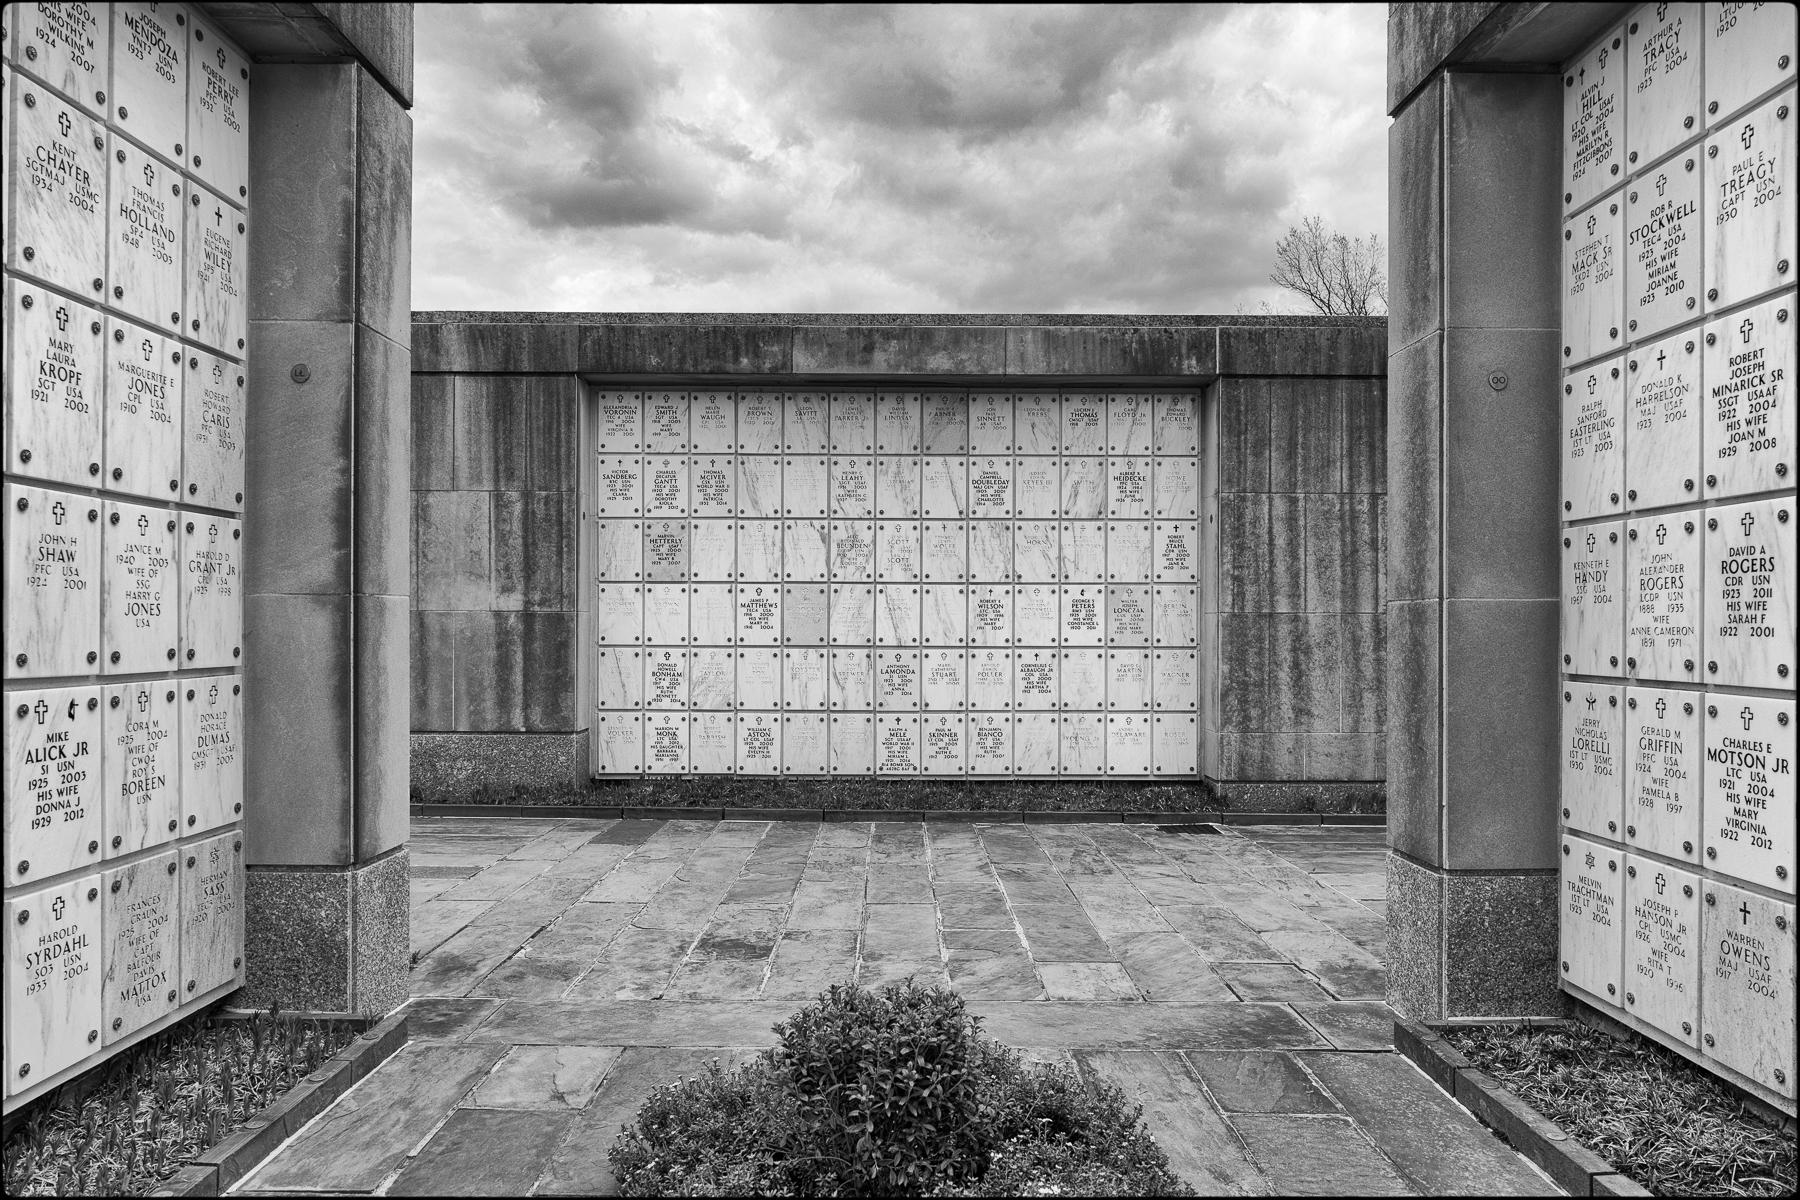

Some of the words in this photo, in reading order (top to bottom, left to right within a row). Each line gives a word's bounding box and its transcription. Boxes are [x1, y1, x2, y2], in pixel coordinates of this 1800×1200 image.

[140, 12, 166, 39] JOSEPH
[1643, 23, 1674, 52] ARTHUR
[1677, 17, 1682, 26] A
[48, 22, 85, 56] WILKINS
[124, 13, 179, 64] MENDOZA
[1643, 29, 1681, 65] TRACY
[36, 27, 56, 48] 1924
[71, 52, 94, 74] 2007
[158, 54, 173, 71] USN
[207, 77, 234, 107] PERRY
[1582, 91, 1603, 113] HILL
[52, 140, 76, 162] KENT
[36, 145, 90, 187] CHAYER
[1732, 157, 1755, 176] PAUL
[26, 157, 65, 186] SGTMAJ
[75, 182, 100, 204] USMC
[69, 193, 94, 214] 2004
[1721, 191, 1745, 210] CAPT
[120, 203, 175, 243] HOLLAND
[1630, 200, 1696, 245] STOCKWELL
[1716, 208, 1738, 226] 1930
[204, 248, 232, 273] WILEY
[1646, 271, 1678, 292] JOANNE
[1665, 280, 1684, 295] 2010
[48, 337, 74, 353] MARY
[46, 350, 76, 367] LAURA
[1729, 348, 1764, 367] ROBERT
[39, 360, 82, 386] KROPF
[1729, 361, 1765, 380] JOSEPH
[66, 386, 83, 399] USA
[128, 377, 166, 399] JONES
[1712, 376, 1765, 398] MINARICK
[1771, 369, 1784, 382] SR
[1636, 384, 1689, 408] HARRELSON
[1718, 395, 1739, 409] SSGT
[1747, 385, 1778, 402] USAAF
[64, 398, 89, 414] 2002
[1718, 409, 1736, 422] 1922
[1748, 399, 1777, 415] 2004
[202, 411, 230, 429] CARIS
[1570, 418, 1615, 438] EASTERLING
[1726, 419, 1741, 432] HIS
[1745, 414, 1768, 427] WIFE
[1728, 431, 1755, 444] JOAN
[1758, 428, 1766, 437] M
[1718, 446, 1737, 458] 1929
[1749, 438, 1776, 453] 2008
[38, 533, 66, 545] JOHN
[38, 546, 77, 562] SHAW
[1729, 546, 1755, 557] DAVID
[1760, 545, 1766, 554] A
[35, 564, 51, 575] PFC
[62, 566, 79, 577] USA
[188, 560, 222, 575] GRANT
[1640, 564, 1684, 576] ALEXANDER
[1721, 557, 1775, 574] ROGERS
[1574, 570, 1608, 584] HANDY
[1640, 576, 1684, 590] ROGERS
[1725, 576, 1744, 586] CDR
[1752, 575, 1771, 585] USN
[125, 591, 152, 600] HARRY
[1722, 589, 1741, 599] 1923
[1753, 588, 1772, 598] 2011
[124, 603, 161, 616] JONES
[1667, 604, 1684, 613] 1935
[1726, 601, 1741, 611] HIS
[1745, 601, 1767, 611] WIFE
[1728, 614, 1758, 624] SARAH
[1761, 614, 1766, 623] F
[1631, 627, 1651, 635] ANNE
[1654, 626, 1694, 635] CAMERON
[1720, 627, 1738, 636] 1922
[1750, 626, 1775, 637] 2001
[46, 732, 69, 743] MIKE
[198, 733, 231, 748] DUMAS
[1572, 737, 1610, 754] LORELLI
[1639, 737, 1683, 754] GRIFFIN
[1723, 737, 1763, 752] CHARLES
[1766, 744, 1772, 754] E
[25, 745, 67, 764] ALICK
[73, 742, 89, 756] JR
[1707, 748, 1765, 770] MOTSON
[1772, 758, 1789, 774] JR
[56, 760, 75, 772] USN
[1726, 767, 1742, 779] LTC
[1750, 772, 1767, 783] USA
[61, 771, 87, 784] 2003
[121, 776, 166, 797] BOREEN
[1652, 777, 1669, 788] WIFE
[37, 788, 55, 801] HIS
[56, 784, 79, 799] WIFE
[1642, 787, 1672, 800] PAMELA
[1719, 779, 1735, 790] 1921
[1747, 784, 1775, 798] 2004
[35, 800, 73, 815] DONNA
[136, 793, 152, 804] USN
[1726, 792, 1741, 804] HIS
[1744, 796, 1767, 810] WIFE
[31, 815, 51, 830] 1929
[64, 808, 85, 822] 2012
[1734, 806, 1759, 821] MARY
[1726, 817, 1767, 836] VIRGINIA
[1720, 828, 1739, 841] 1922
[1751, 836, 1772, 850] 2012
[1567, 880, 1614, 906] TRACHTMAN
[1642, 898, 1671, 915] JOSEPH
[1635, 906, 1672, 929] HANSON
[1678, 923, 1687, 935] JR
[39, 924, 78, 946] HAROLD
[1726, 929, 1765, 951] WARREN
[26, 934, 89, 970] SYRDAHL
[1720, 940, 1771, 971] OWENS
[63, 954, 82, 969] USN
[120, 971, 167, 1002] MATTOX
[1747, 980, 1775, 1000] 2004
